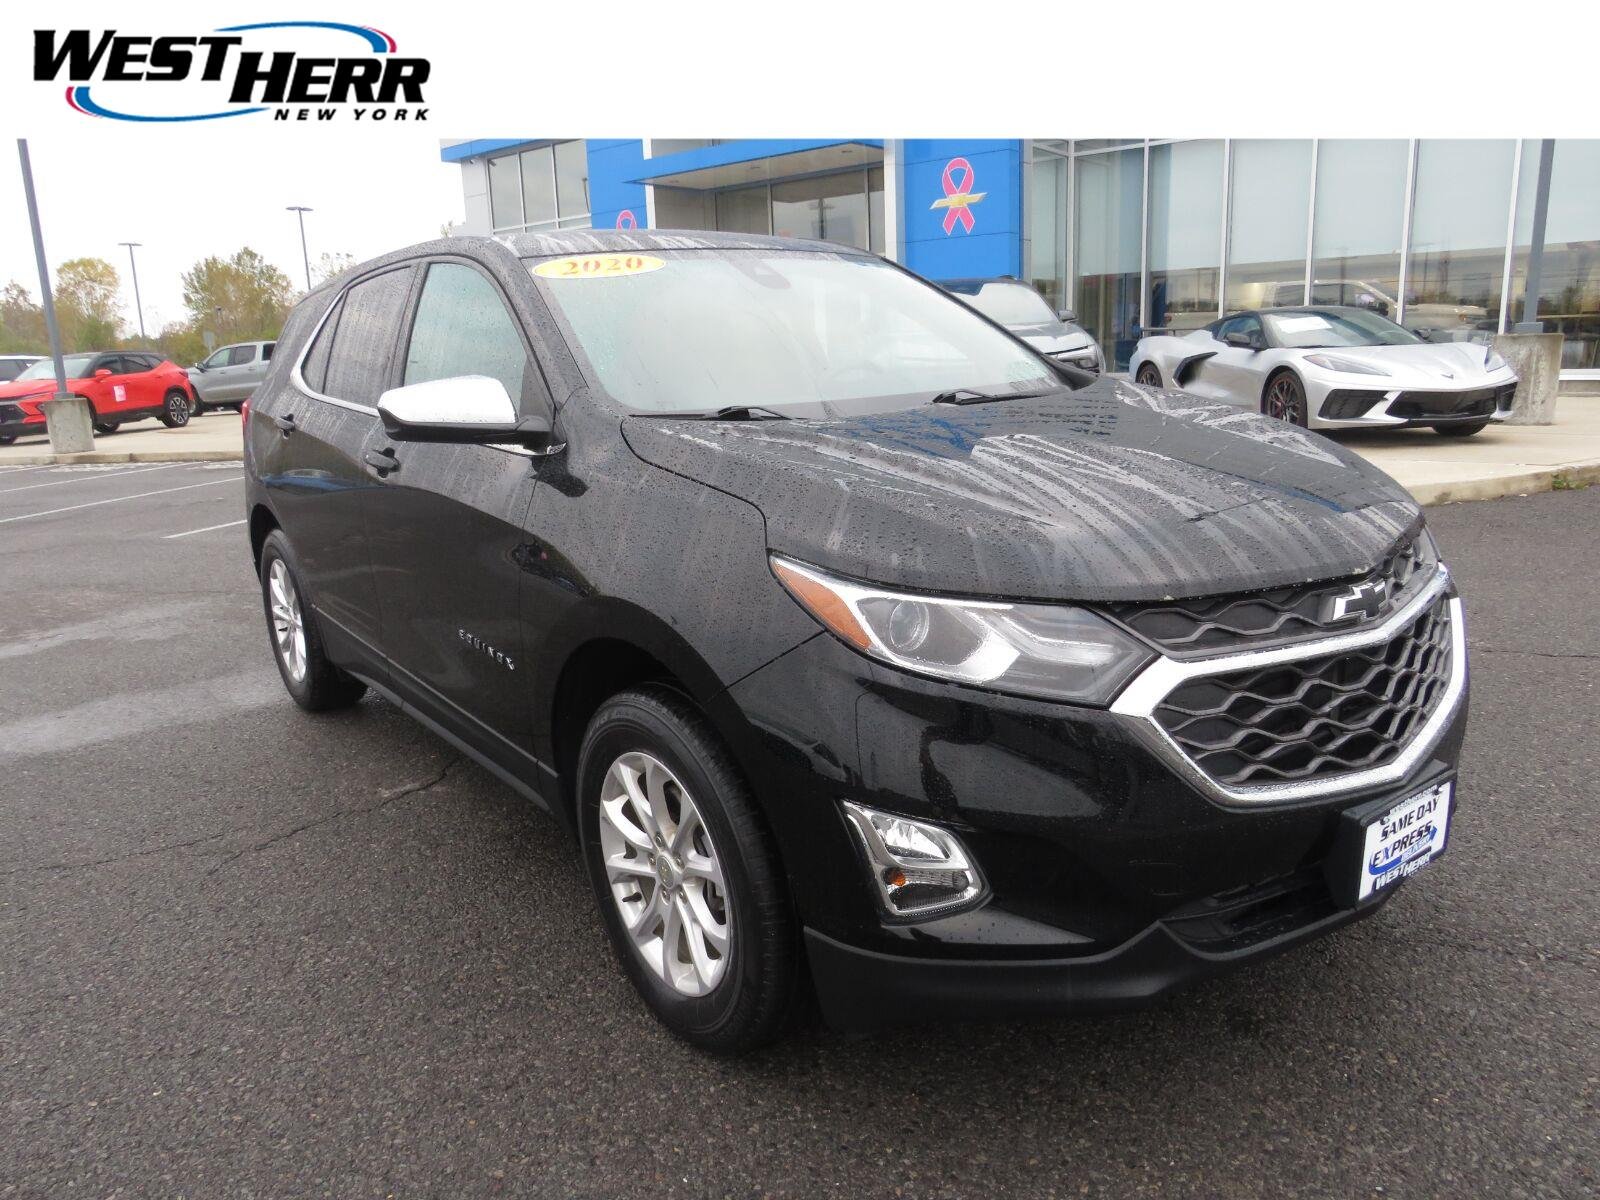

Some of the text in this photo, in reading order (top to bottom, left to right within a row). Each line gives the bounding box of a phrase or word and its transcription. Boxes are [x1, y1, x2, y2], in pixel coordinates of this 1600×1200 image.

[562, 257, 643, 276] 2020
[1380, 810, 1415, 842] SAME
[1416, 796, 1440, 821] DAY
[1373, 820, 1432, 867] EXPRESS
